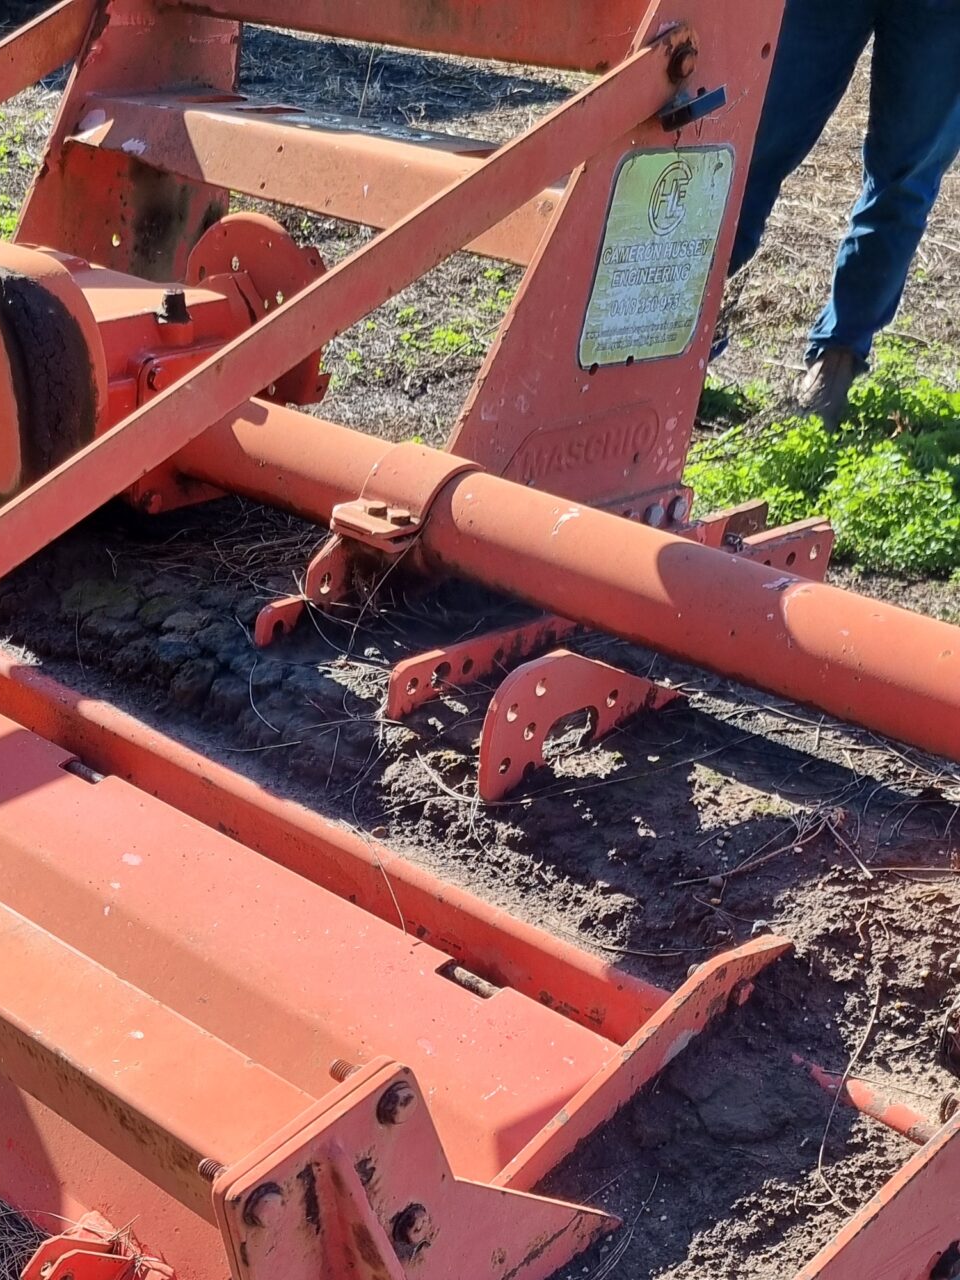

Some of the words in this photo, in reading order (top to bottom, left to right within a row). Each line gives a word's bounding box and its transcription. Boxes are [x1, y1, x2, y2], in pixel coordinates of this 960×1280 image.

[602, 243, 663, 265] CAMERON
[662, 239, 709, 260] HUSSEY
[611, 263, 691, 288] ENGINEERING
[515, 421, 654, 480] MASCHIO
